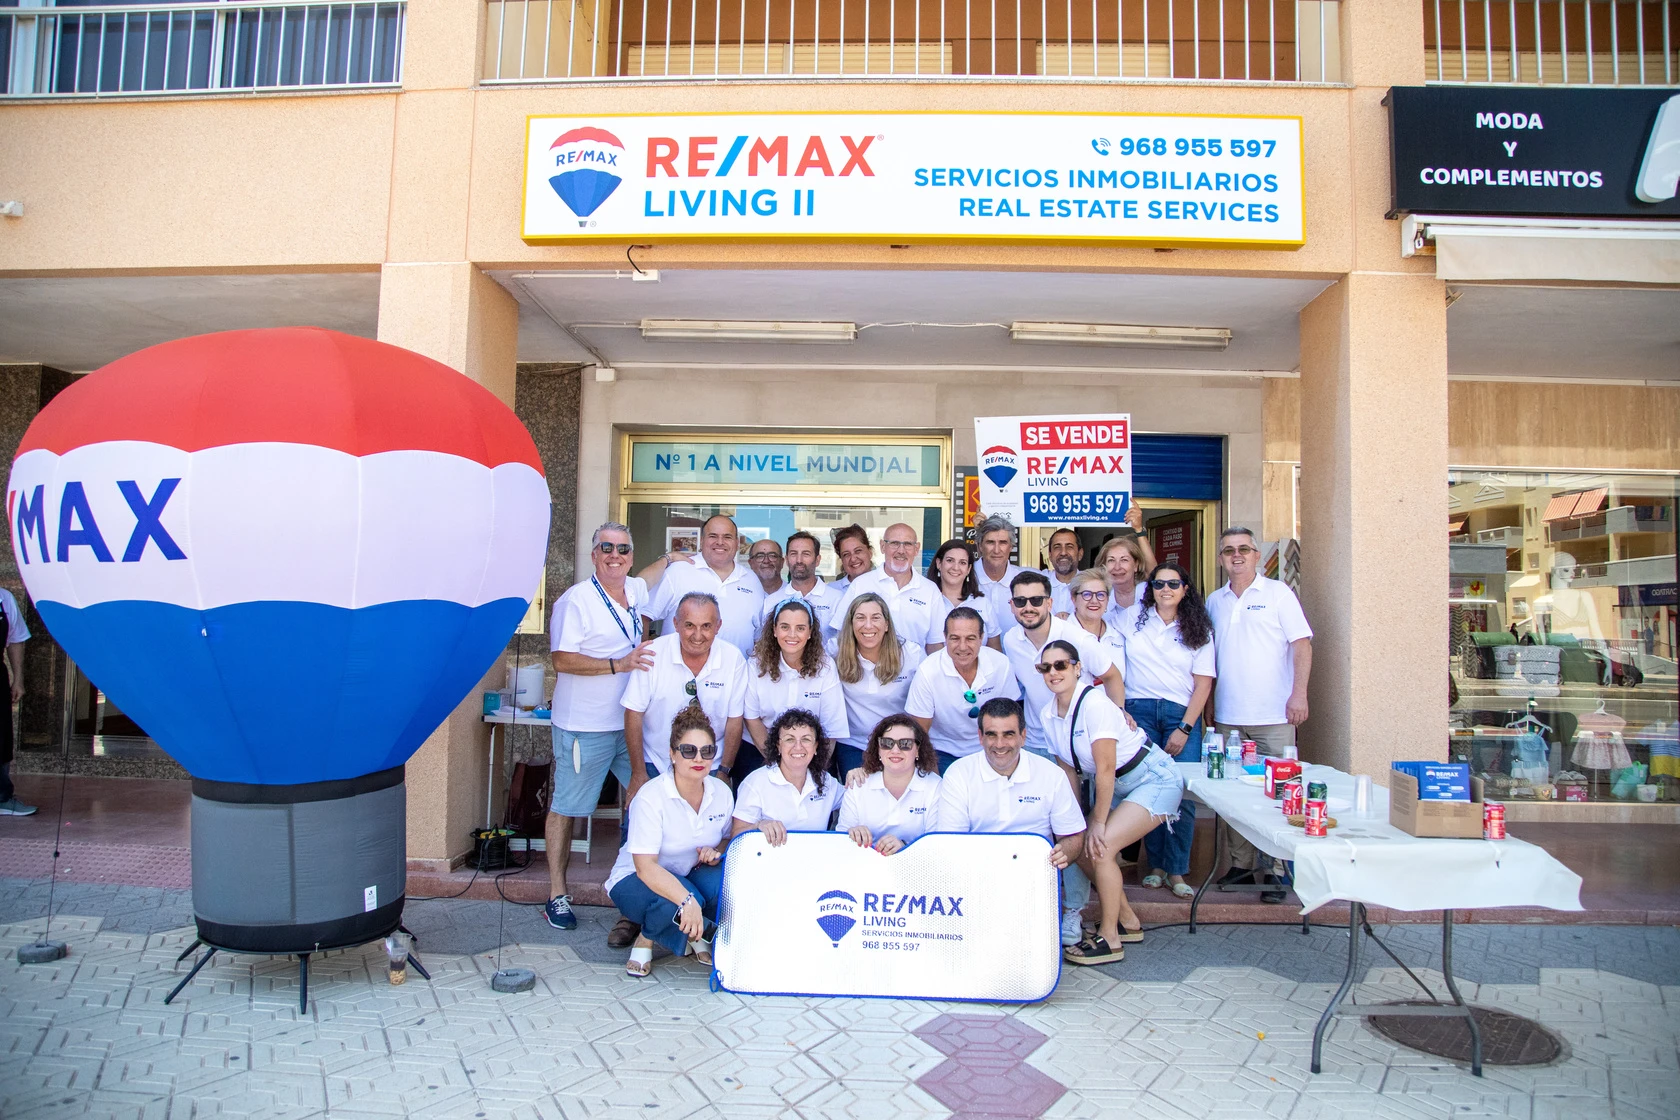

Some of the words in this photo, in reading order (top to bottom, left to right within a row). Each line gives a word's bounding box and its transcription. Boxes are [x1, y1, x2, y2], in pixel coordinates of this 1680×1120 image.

[1475, 112, 1544, 130] MODA
[1119, 137, 1168, 156] 968
[1174, 138, 1223, 157] 955
[1230, 139, 1277, 158] 597
[1502, 141, 1519, 158] Y
[556, 150, 618, 168] RE/MAX
[914, 168, 1059, 189] SERVICIOS
[1069, 170, 1279, 193] INMOBILIARIOS
[1420, 168, 1603, 189] COMPLEMENTOS
[644, 188, 778, 217] LIVING
[793, 189, 815, 217] II
[959, 197, 1030, 218] REAL
[1040, 199, 1139, 219] ESTATE
[1148, 201, 1280, 223] SERVICES
[1025, 426, 1050, 445] SE
[1055, 425, 1125, 445] VENDE
[687, 453, 696, 471] 1
[703, 454, 721, 471] A
[729, 454, 798, 472] NIVEL
[806, 455, 918, 474] MUNDIAL
[985, 456, 1015, 465] RE/MAX
[1027, 455, 1125, 475] RE/MAX
[1027, 477, 1069, 487] LIVING
[1030, 495, 1059, 514] 968
[1063, 495, 1091, 514] 955
[1096, 494, 1124, 514] 597
[1048, 514, 1108, 522] www.remaxliving.es
[819, 902, 854, 914] RE/MAX
[863, 892, 964, 917] RE/MAX
[863, 915, 906, 928] LIVING
[861, 930, 903, 939] SERVICIOS
[905, 932, 964, 942] INMOBILIARIOS
[862, 941, 880, 950] 968
[882, 942, 900, 951] 955
[903, 943, 920, 952] 597
